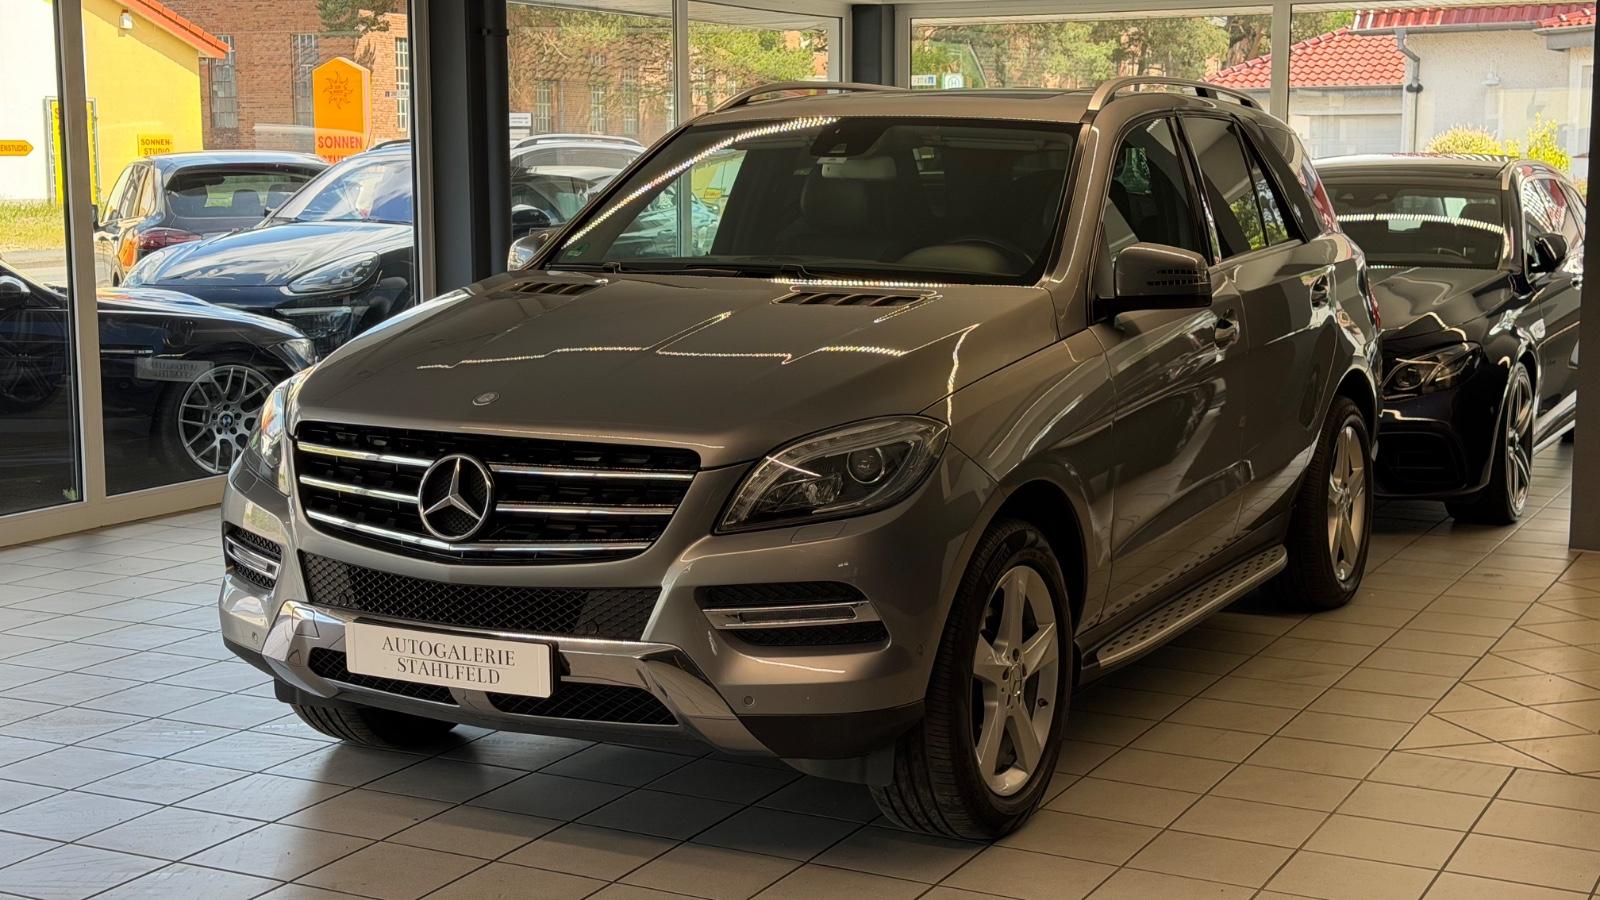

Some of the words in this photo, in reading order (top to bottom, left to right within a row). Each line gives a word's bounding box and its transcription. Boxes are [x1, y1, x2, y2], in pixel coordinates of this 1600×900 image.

[318, 135, 362, 149] SONNEN
[382, 636, 516, 667] AUTOGALERIE
[397, 657, 501, 685] STAHLFELD
